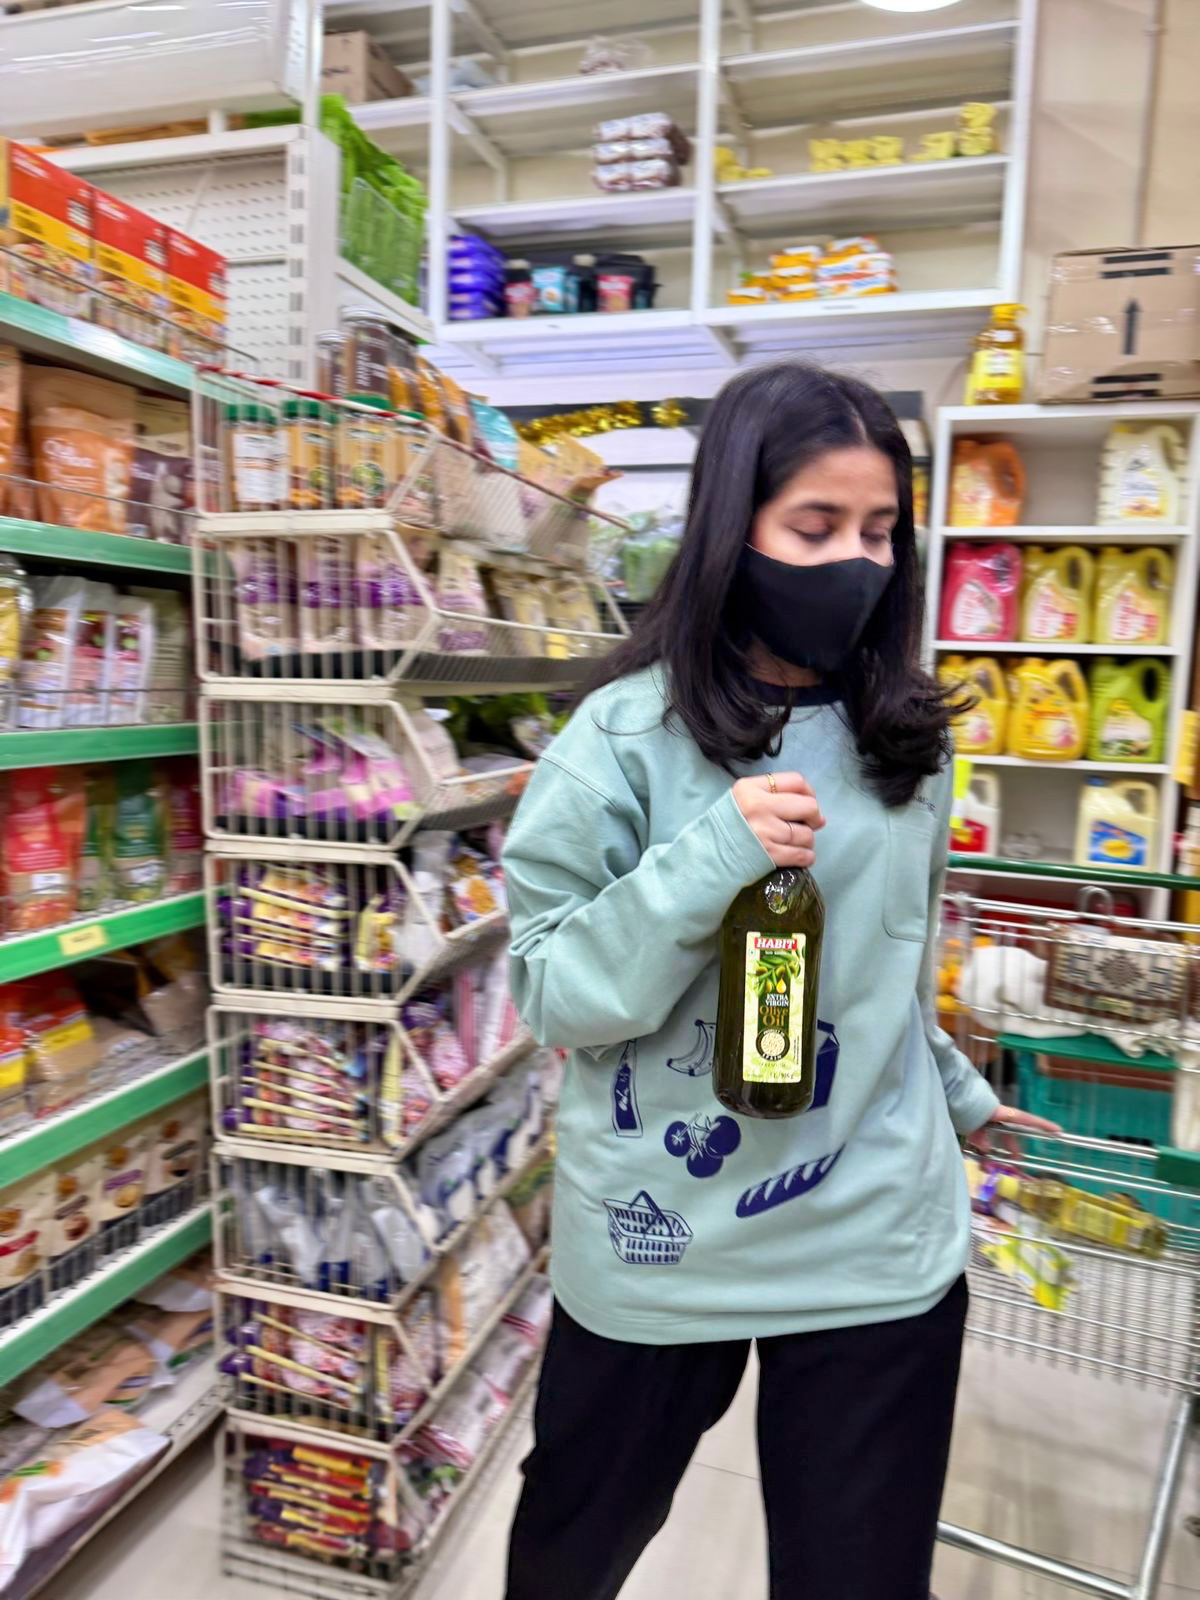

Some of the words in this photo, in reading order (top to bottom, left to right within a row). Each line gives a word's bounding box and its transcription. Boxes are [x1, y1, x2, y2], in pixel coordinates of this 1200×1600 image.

[757, 938, 795, 948] HABIT
[759, 1006, 788, 1016] Olive
[763, 1015, 785, 1026] Oil
